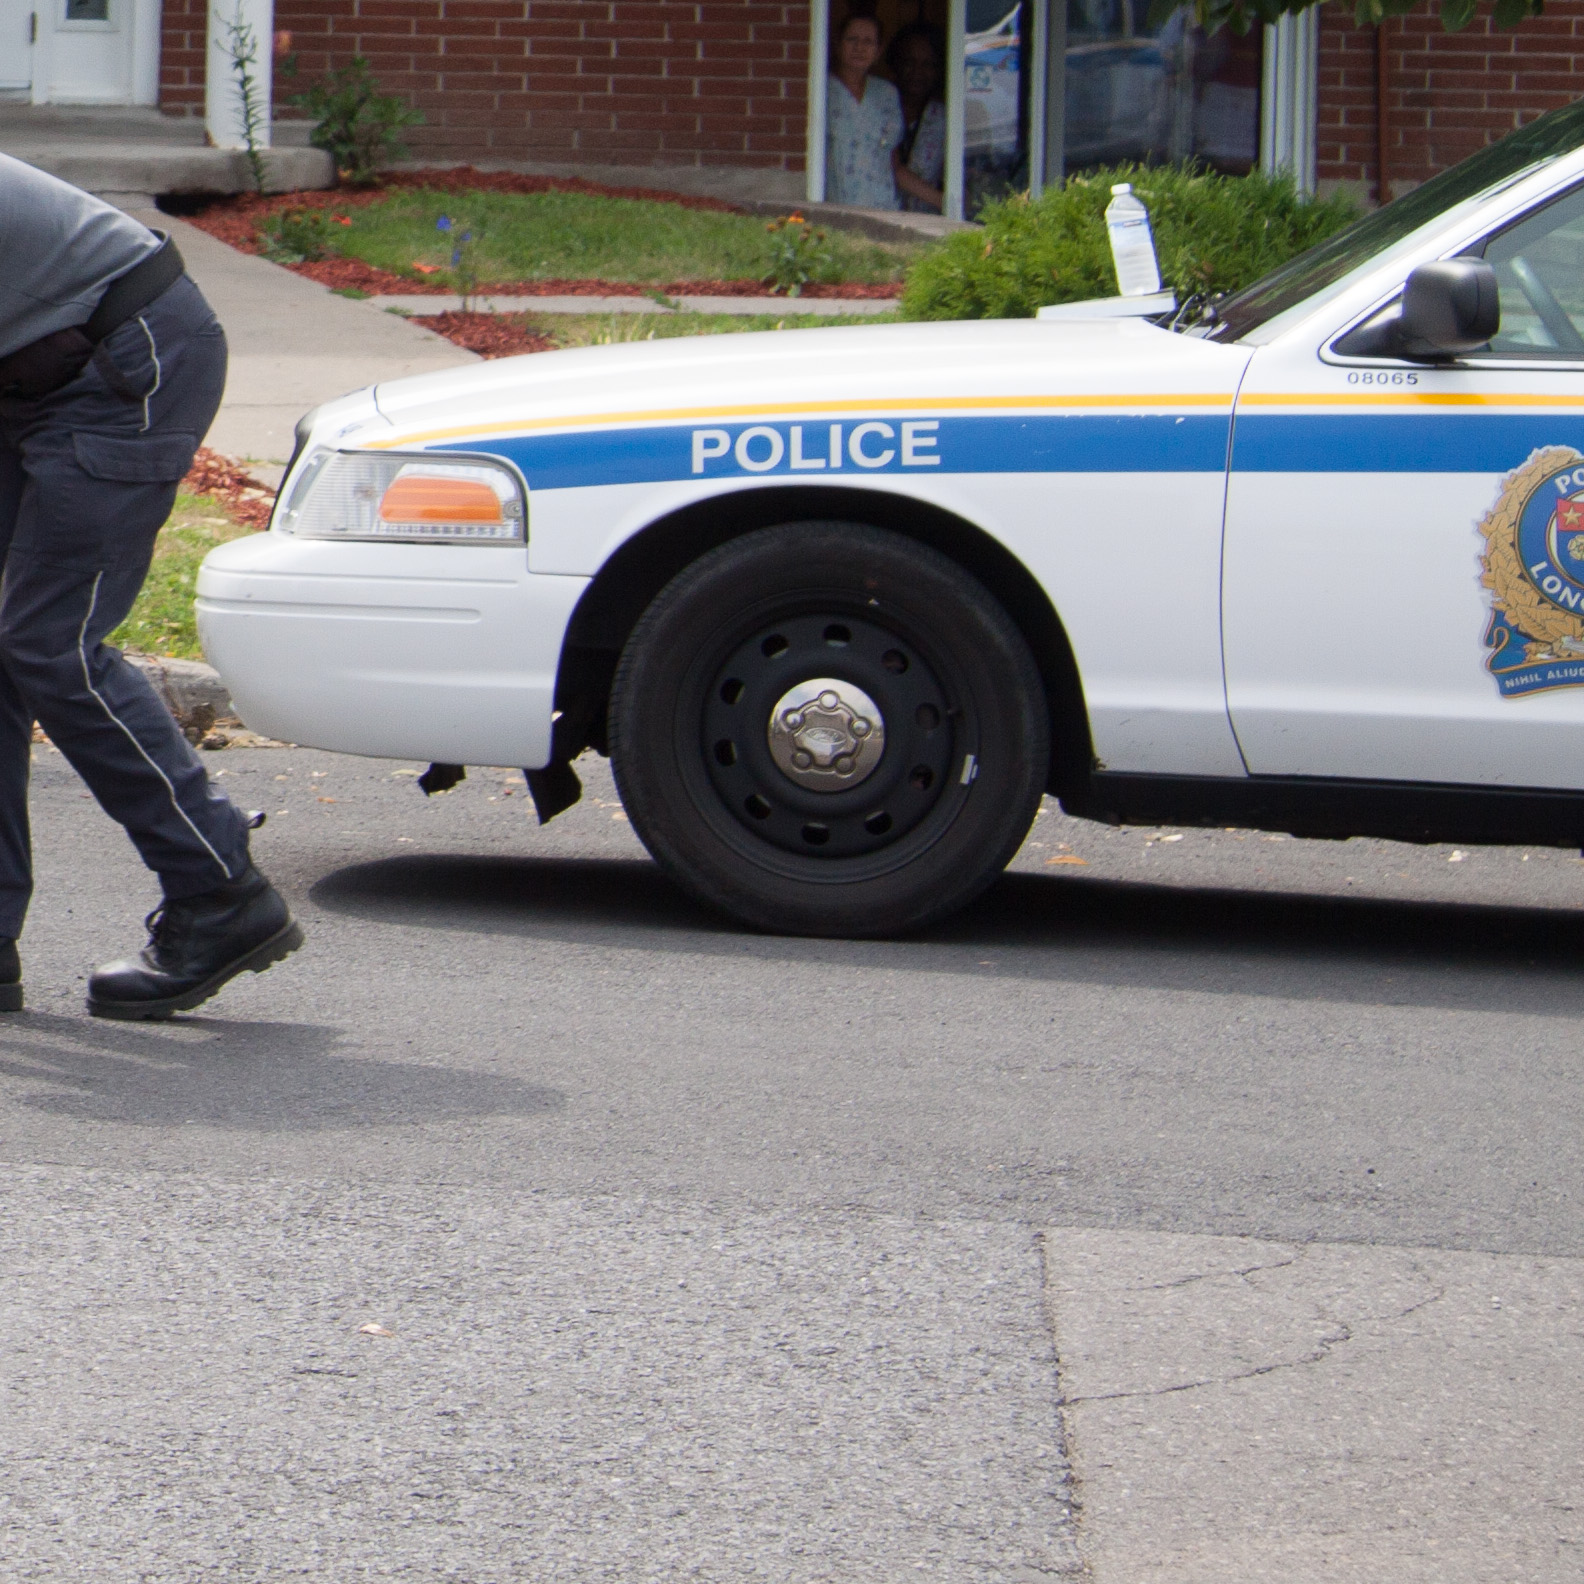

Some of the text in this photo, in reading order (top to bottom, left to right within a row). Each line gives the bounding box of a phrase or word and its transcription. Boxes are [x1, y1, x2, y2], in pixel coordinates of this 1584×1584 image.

[1347, 372, 1419, 385] 08065
[691, 420, 942, 474] POLICE
[1530, 560, 1584, 609] LON
[1504, 673, 1542, 689] NIHIL
